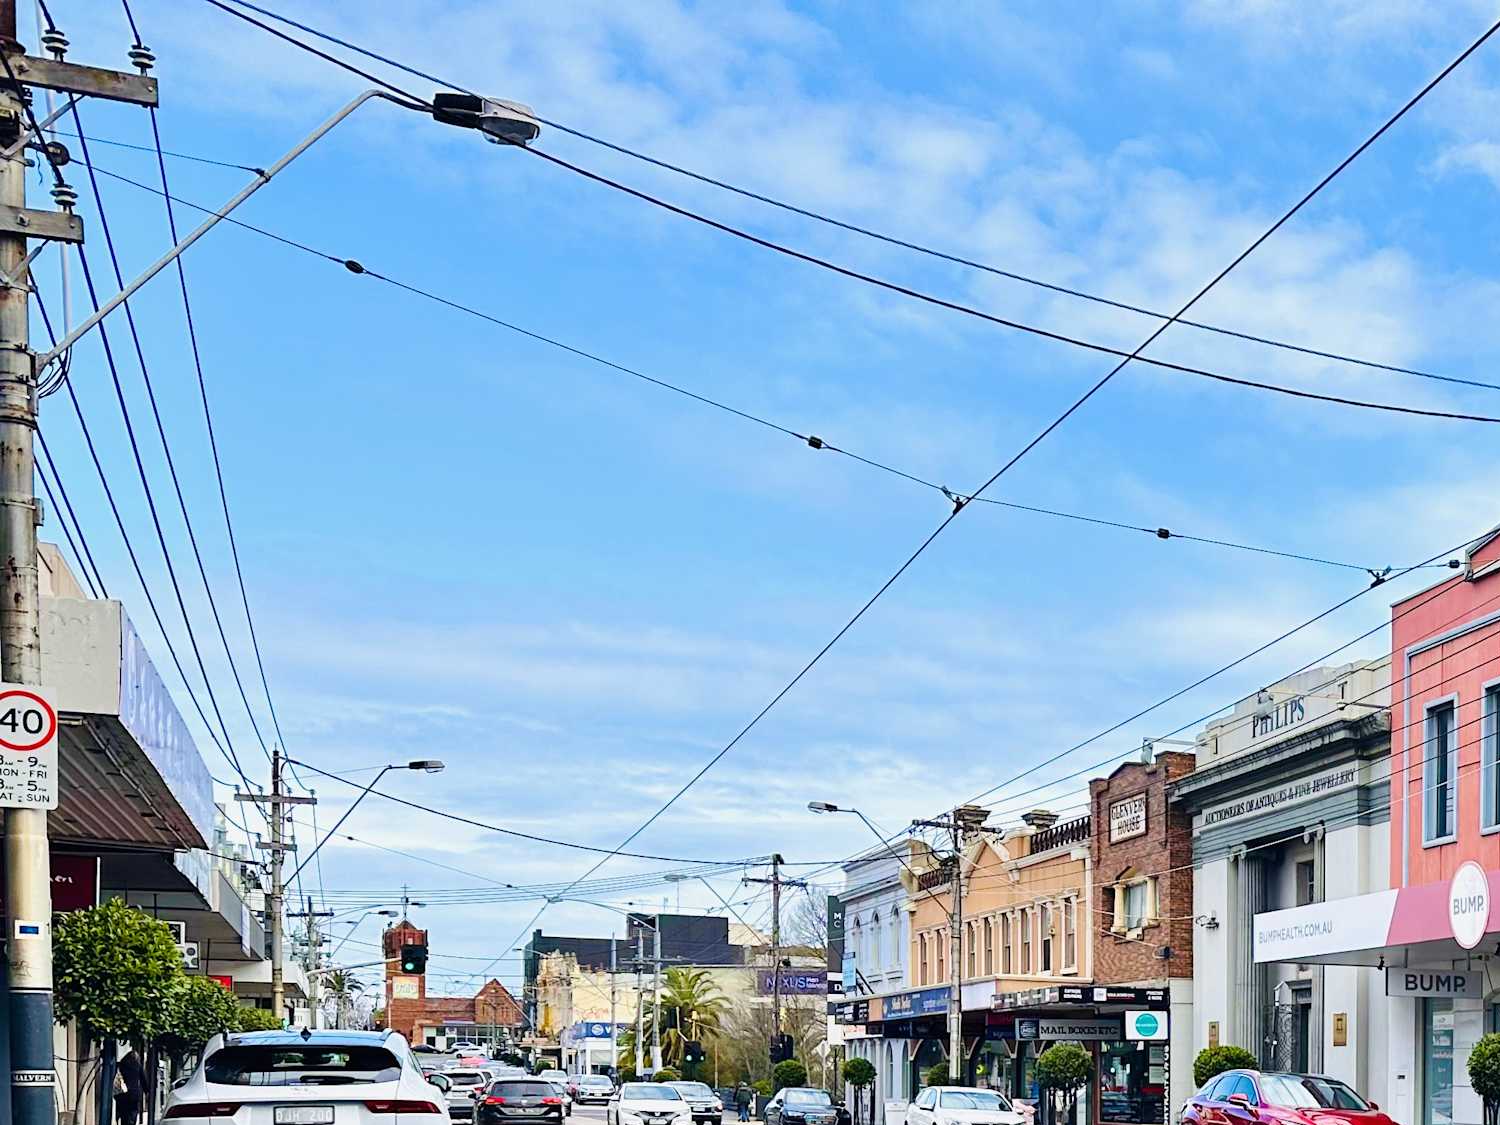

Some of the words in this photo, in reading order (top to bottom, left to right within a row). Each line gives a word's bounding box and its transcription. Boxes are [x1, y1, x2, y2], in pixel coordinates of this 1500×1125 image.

[0, 708, 43, 734] 40
[0, 769, 18, 777] ON
[29, 770, 47, 778] FRI
[26, 793, 50, 802] SUN
[1117, 815, 1140, 835] HOUSE
[1258, 920, 1334, 944] BUMPHEALTH.COM.AU
[766, 977, 806, 988] NXUS
[1041, 1026, 1066, 1034] MAIL
[1069, 1026, 1097, 1035] BOXES
